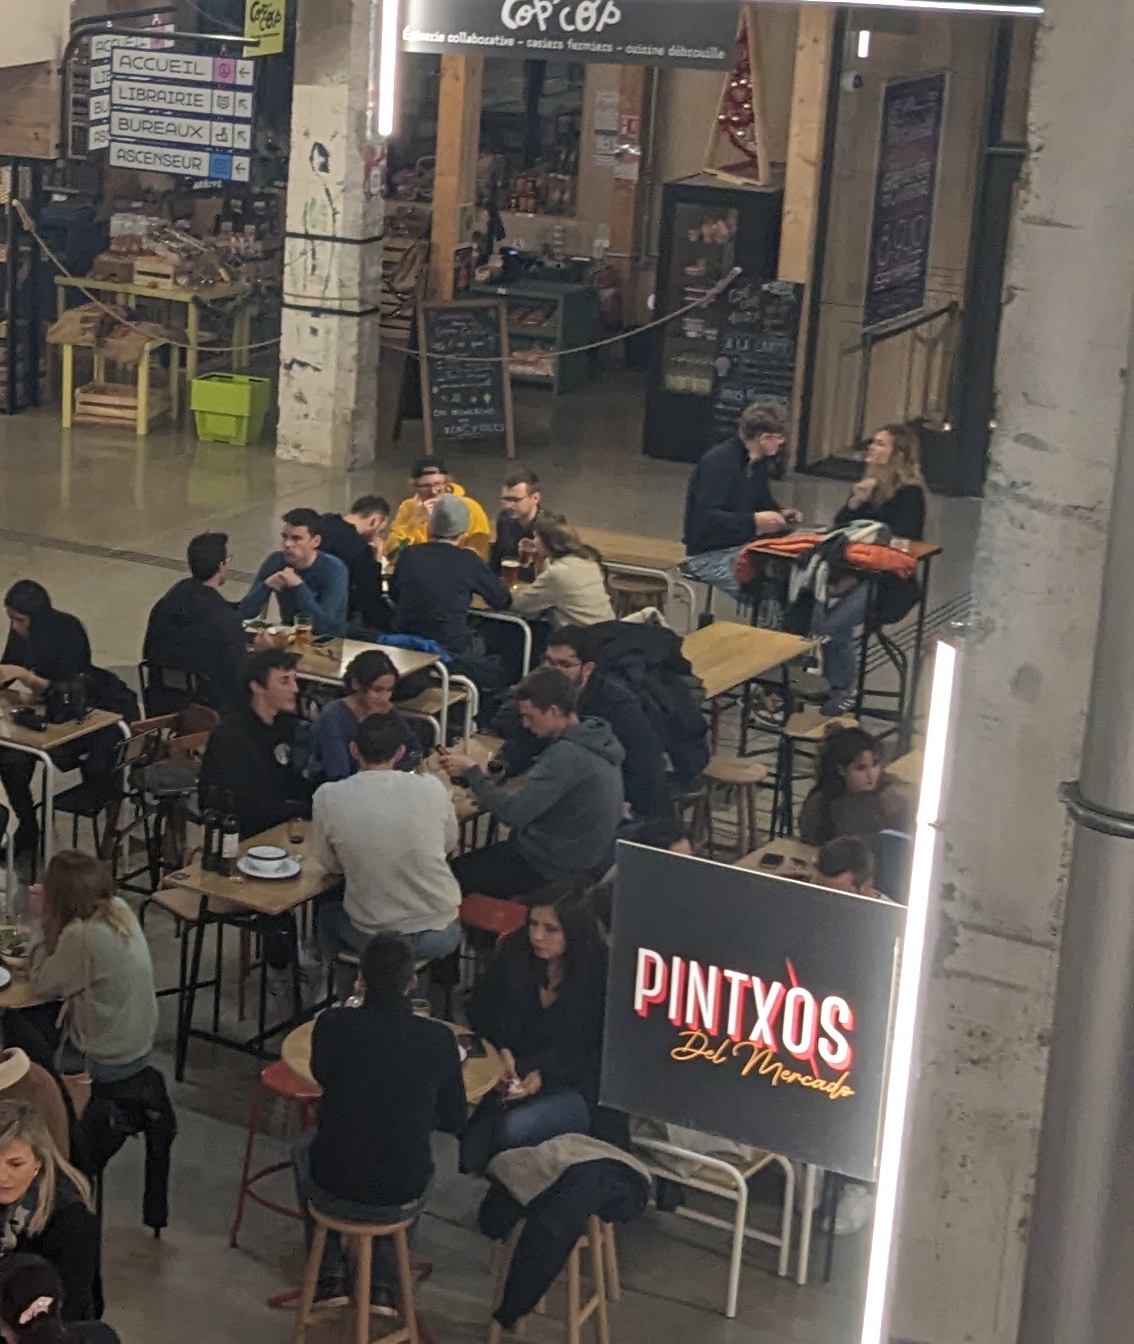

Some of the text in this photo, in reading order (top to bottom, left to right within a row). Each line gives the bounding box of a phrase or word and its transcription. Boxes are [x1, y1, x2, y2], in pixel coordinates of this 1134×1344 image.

[448, 31, 515, 47] collaborative
[119, 55, 204, 76] ACCUEIL
[118, 86, 203, 108] LIBRAIRIE
[118, 118, 203, 139] BUREAUX
[116, 149, 202, 170] ASCENSEUR
[634, 947, 856, 1072] PINTXOS
[670, 1030, 856, 1099] Del Mercado
